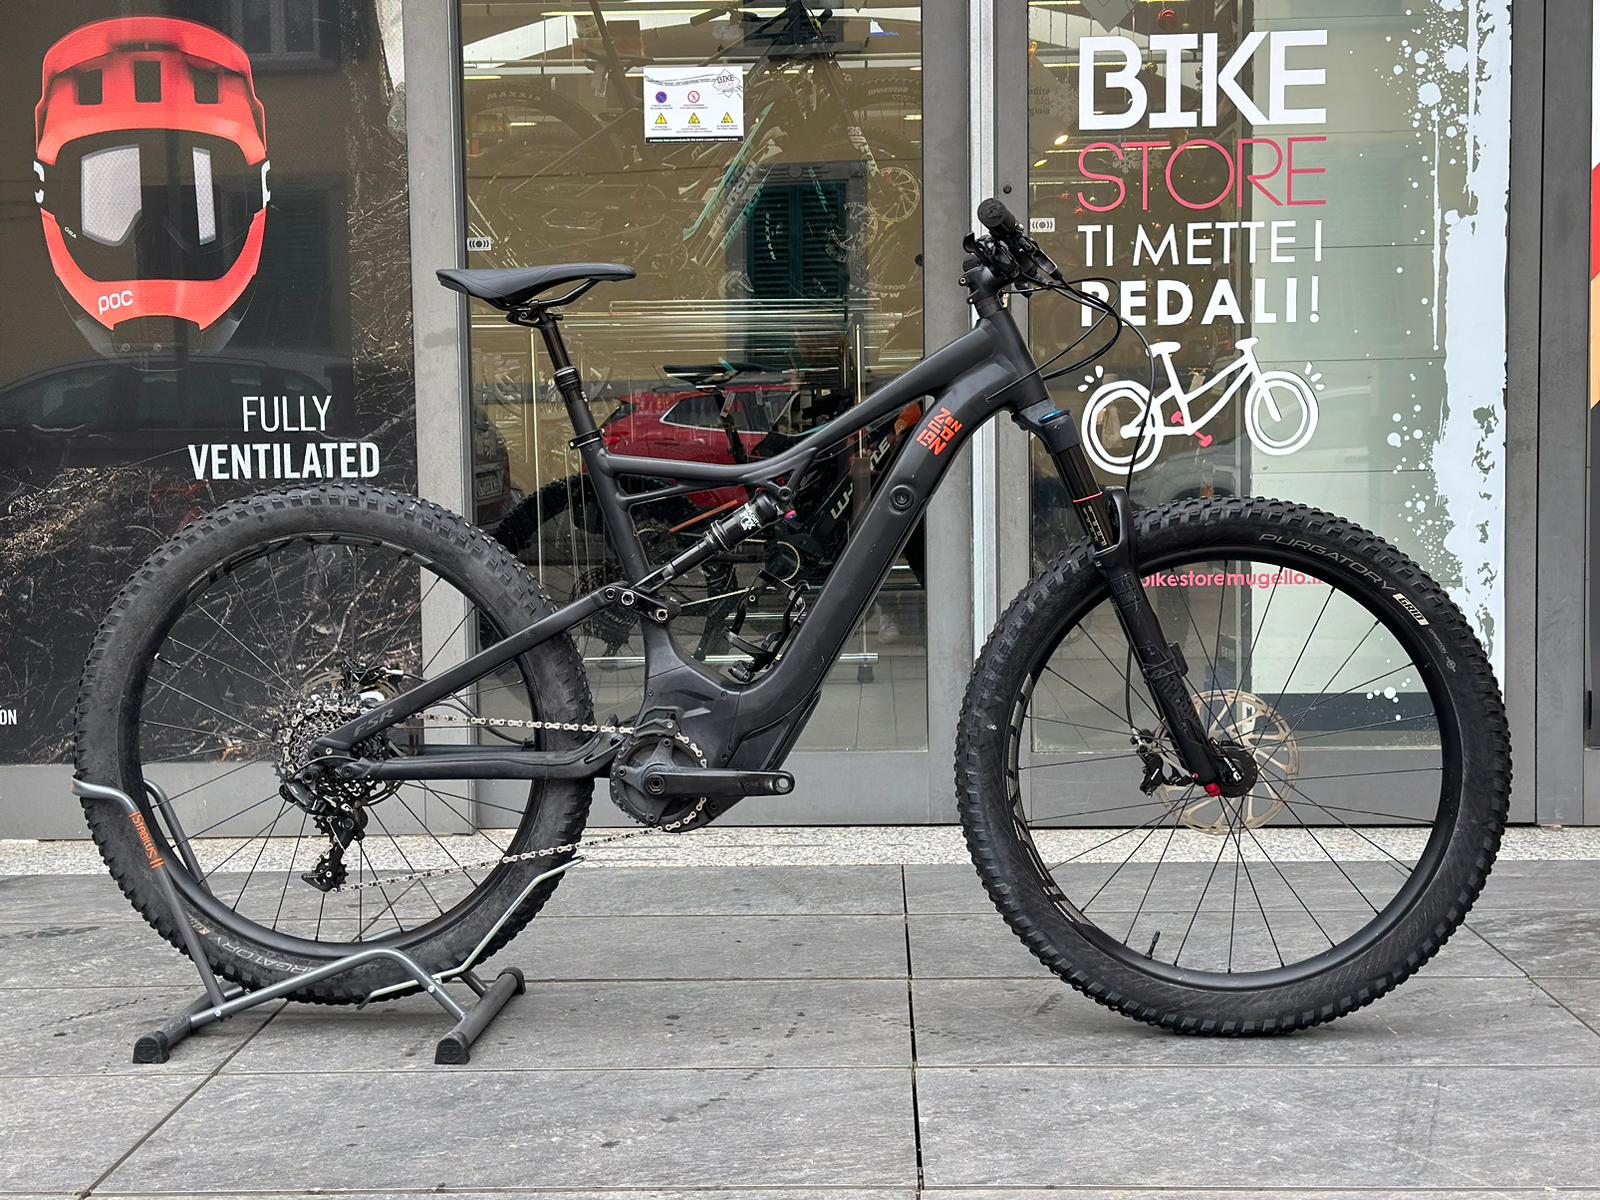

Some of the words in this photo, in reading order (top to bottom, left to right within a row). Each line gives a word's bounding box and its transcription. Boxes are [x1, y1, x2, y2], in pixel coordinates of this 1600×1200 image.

[1078, 30, 1328, 131] BIKE
[1078, 136, 1328, 213] STORE
[1078, 224, 1114, 267] TI
[1132, 220, 1297, 266] METTE
[1314, 219, 1323, 262] I
[1081, 275, 1321, 328] PEDALI!
[242, 395, 333, 432] FULLY
[188, 443, 381, 480] VENTILATED
[1259, 533, 1397, 591] PURGATORY
[1398, 597, 1426, 622] GRID
[354, 708, 394, 737] FSR
